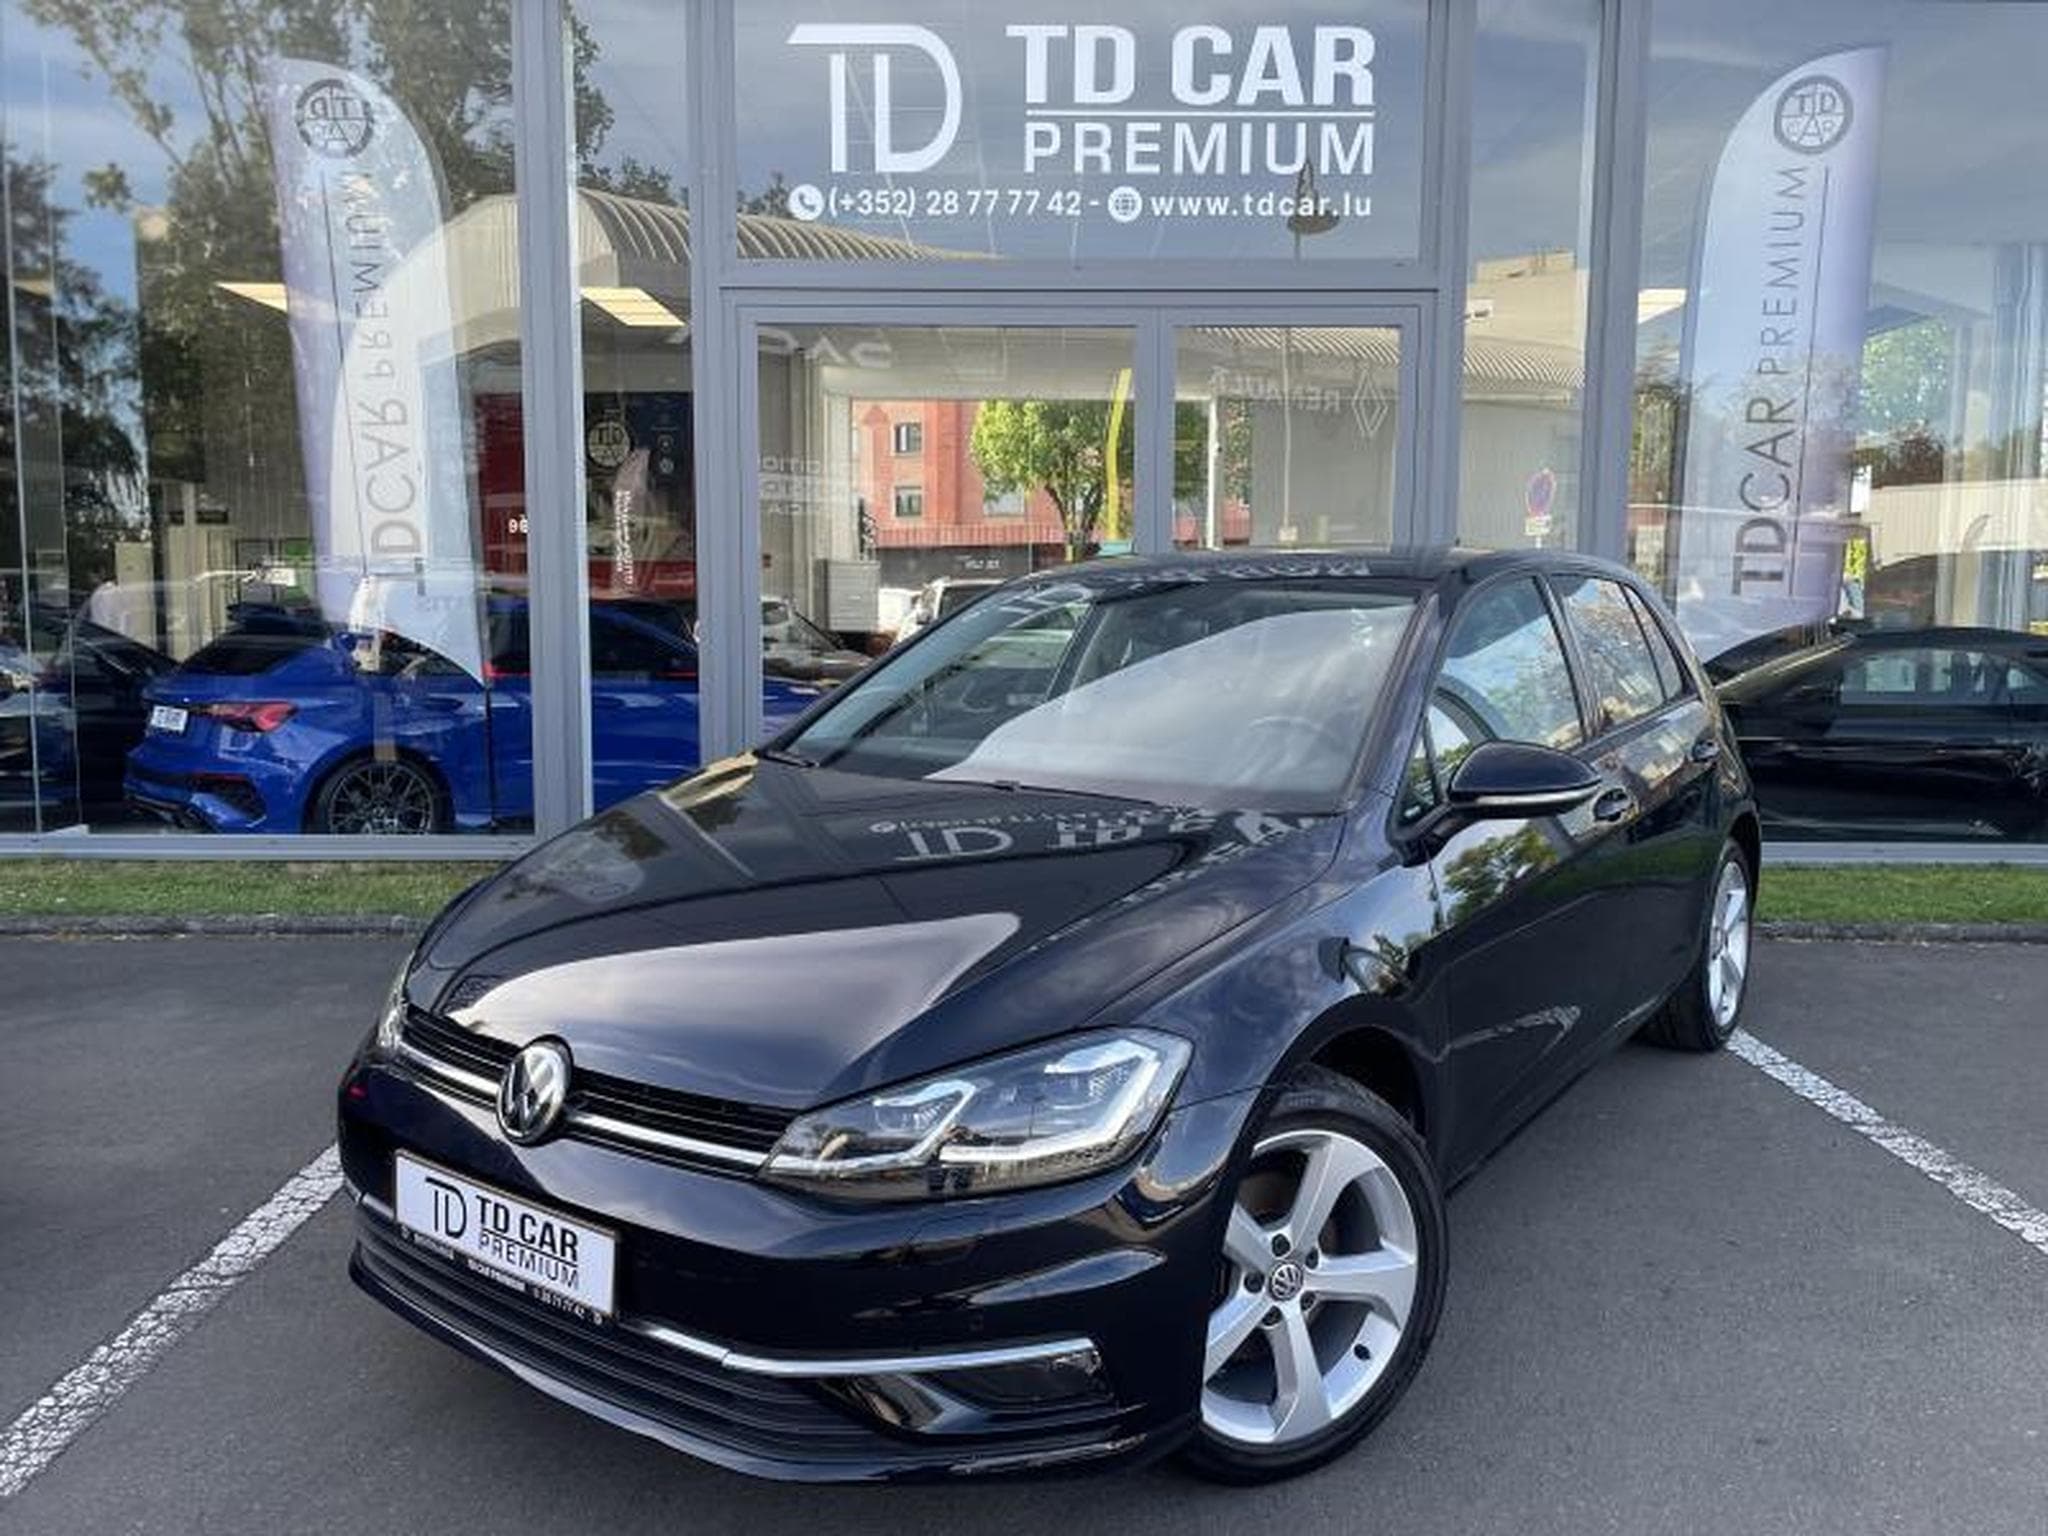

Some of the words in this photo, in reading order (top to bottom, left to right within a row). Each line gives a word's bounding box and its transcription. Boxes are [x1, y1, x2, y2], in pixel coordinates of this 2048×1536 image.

[1006, 25, 1136, 104] TD
[1171, 25, 1376, 106] CAR
[1023, 122, 1374, 175] PREMIUM
[829, 186, 916, 219] (+352)
[926, 190, 959, 216] 28
[966, 189, 999, 216] 77
[1007, 189, 1041, 216] 77
[1046, 190, 1082, 216] 42
[1150, 191, 1373, 217] www.tdcar.lu
[1757, 166, 1808, 376] PREMIUM
[476, 1194, 511, 1235] TD
[520, 1212, 579, 1263] CAR
[478, 1229, 580, 1291] PREMIUM
